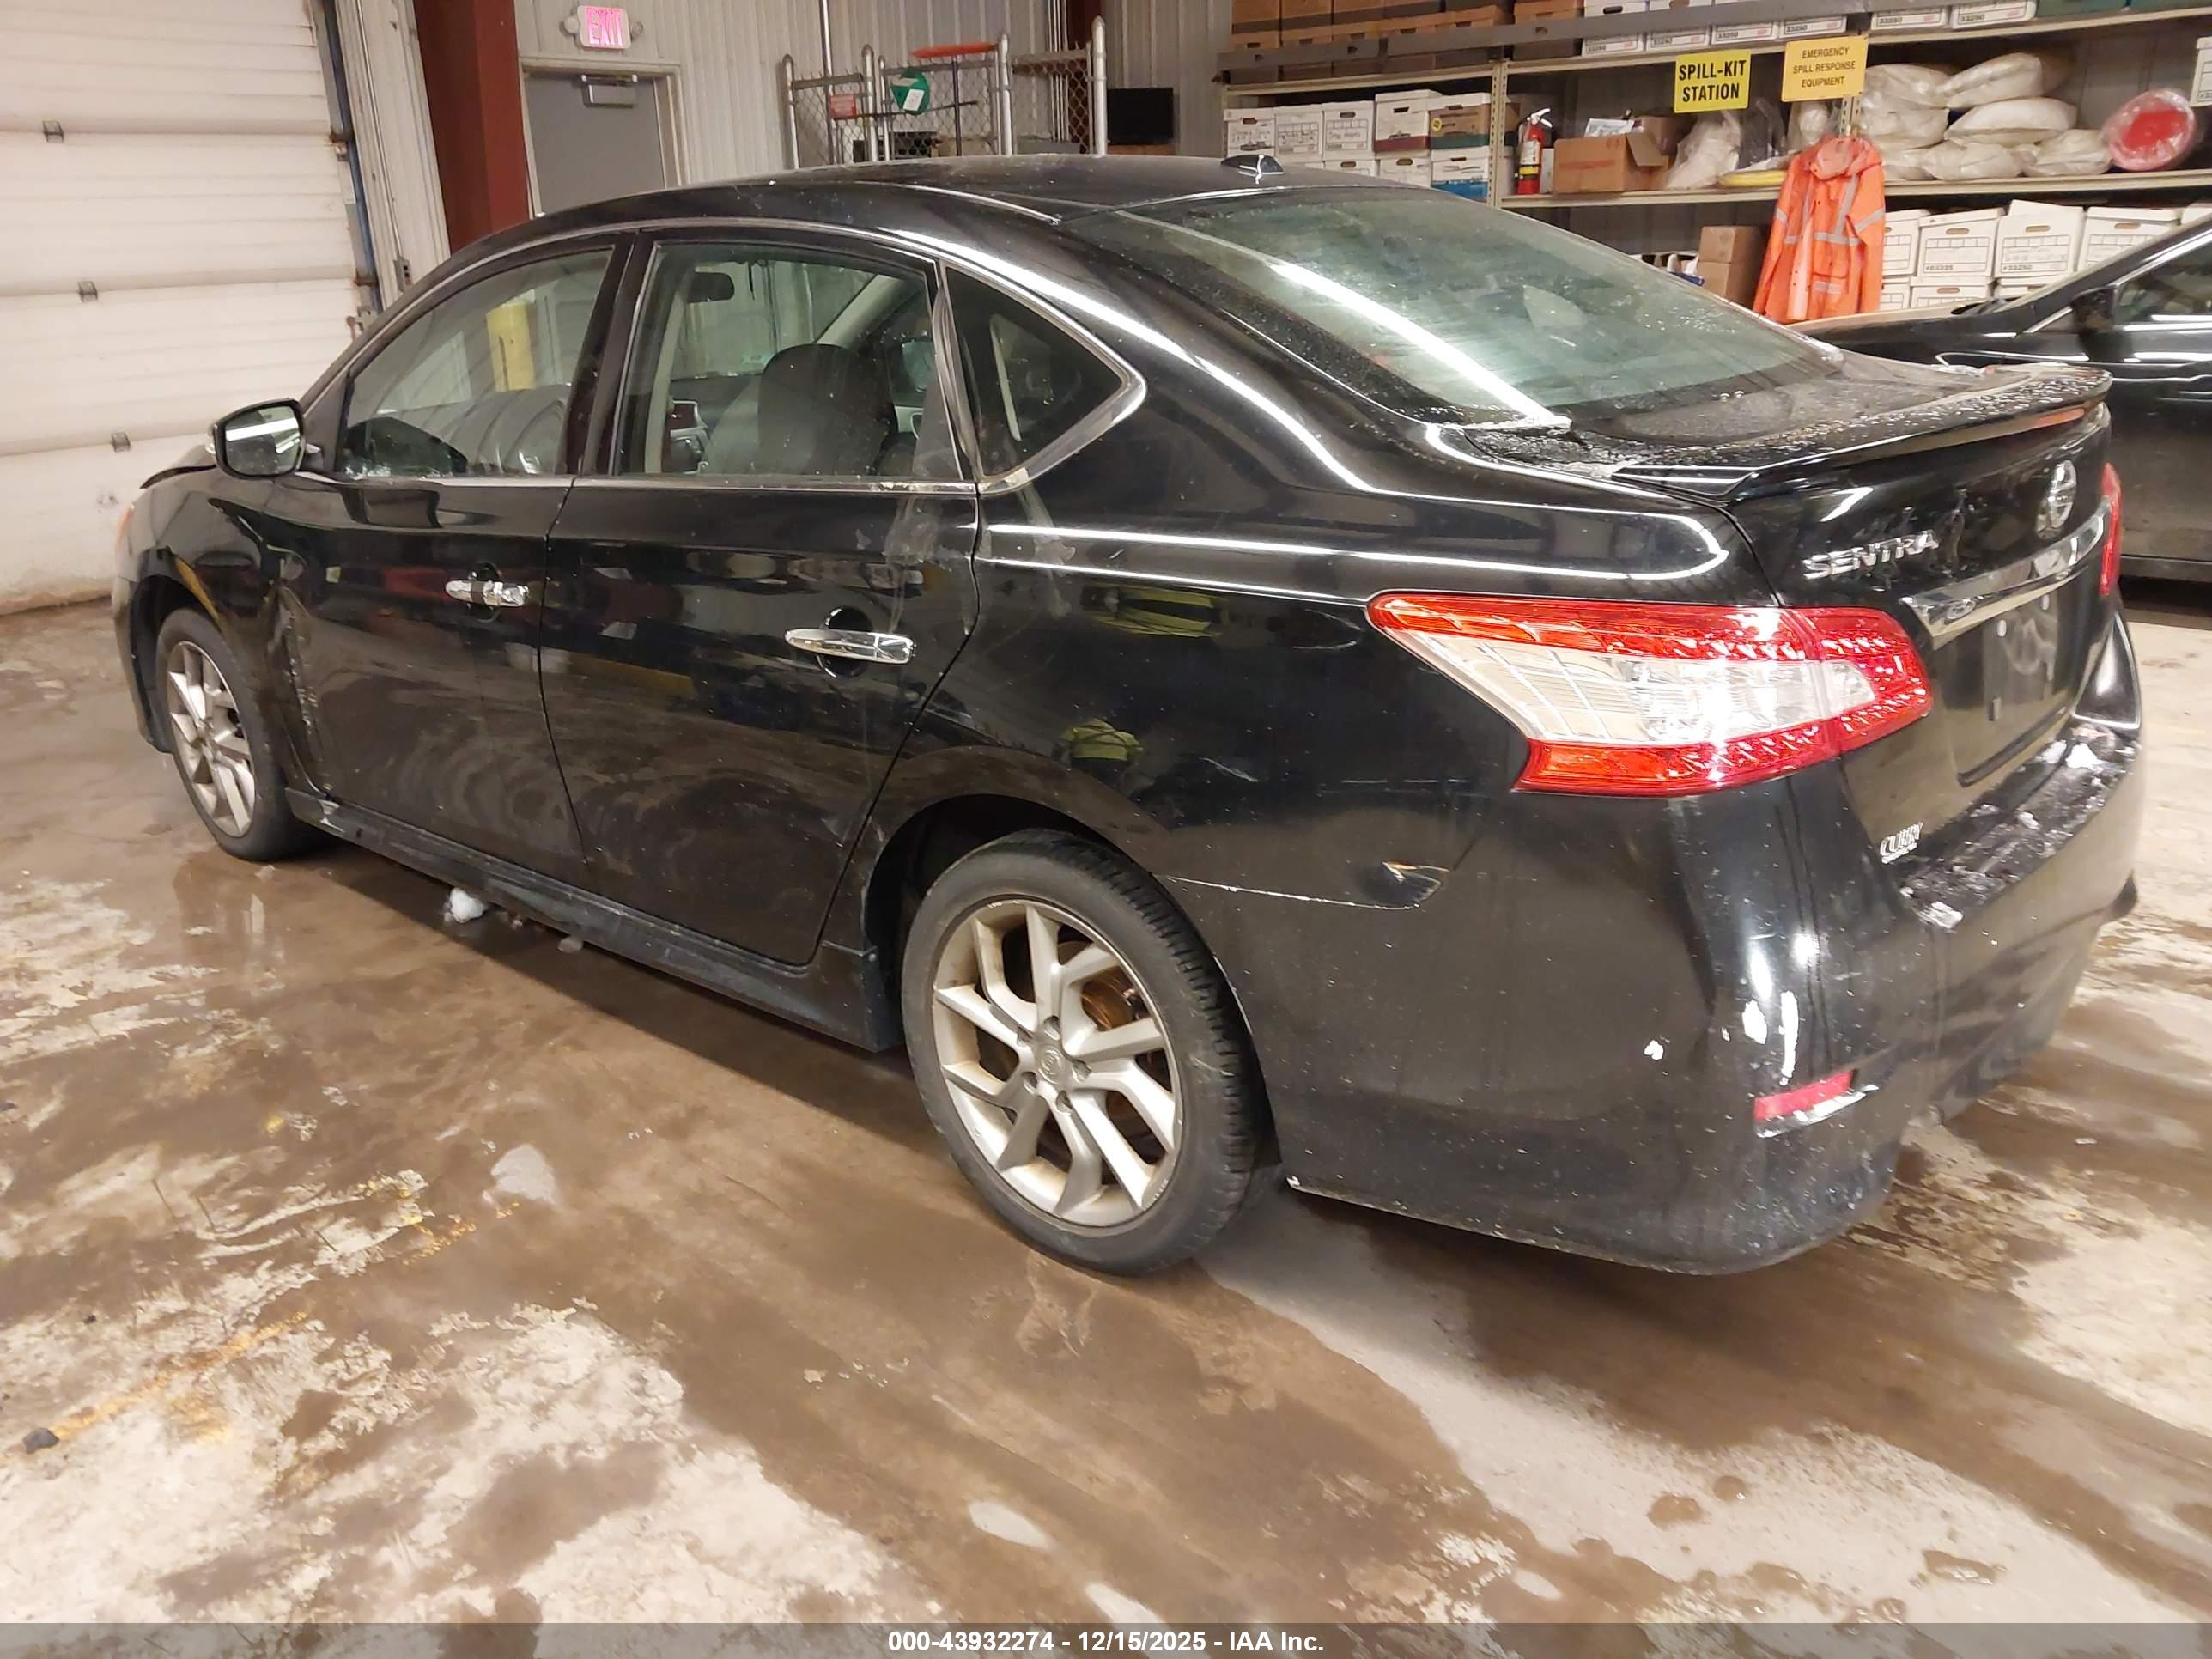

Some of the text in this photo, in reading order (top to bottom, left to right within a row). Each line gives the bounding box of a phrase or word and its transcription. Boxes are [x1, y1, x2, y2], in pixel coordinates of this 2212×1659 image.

[586, 7, 623, 46] EXIT
[1802, 47, 1849, 59] EMERGENCY
[1679, 60, 1747, 81] SPILL-KIT
[1793, 61, 1856, 75] SPILL RESPONSE
[1683, 82, 1740, 102] STATION
[1802, 76, 1844, 88] EQUIPMENT
[1802, 529, 1939, 580] SENTRA
